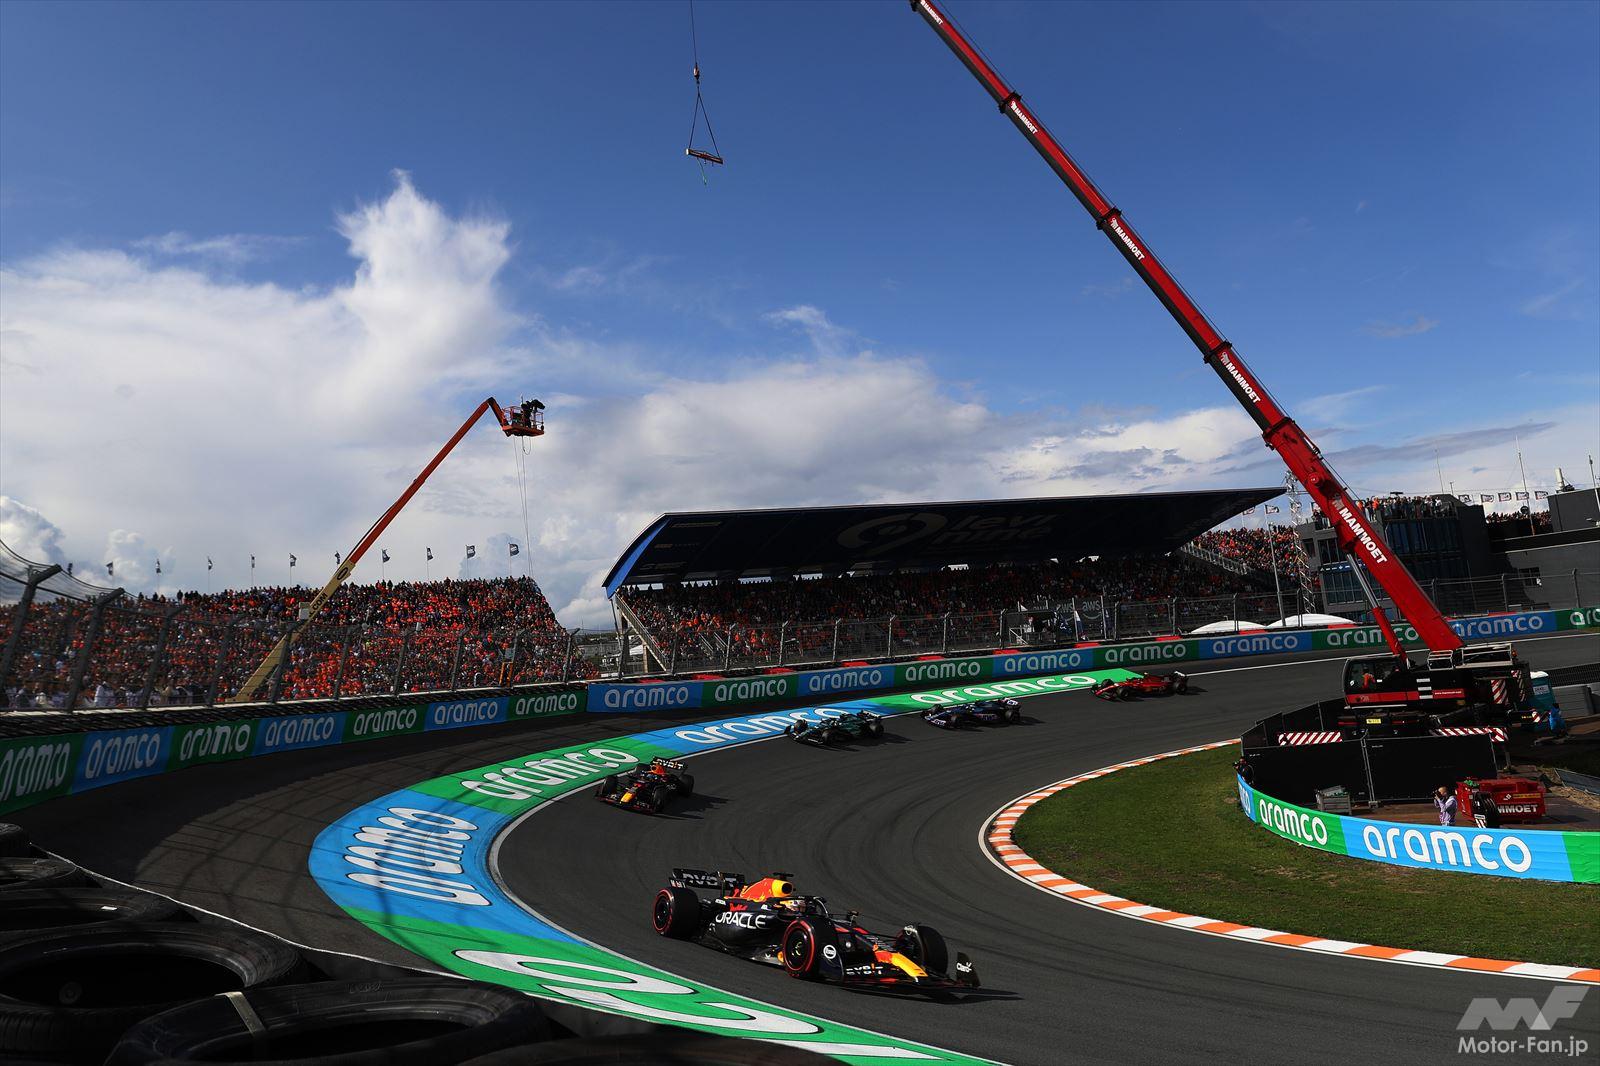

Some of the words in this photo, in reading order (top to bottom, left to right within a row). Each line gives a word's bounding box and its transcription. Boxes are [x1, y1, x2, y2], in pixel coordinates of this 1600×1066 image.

[1014, 107, 1038, 135] MAMMOET
[1114, 227, 1145, 262] MAMMOET
[1225, 362, 1261, 404] MAMMOET
[1338, 508, 1388, 564] MAMMOET
[1082, 600, 1100, 612] aws
[1105, 643, 1187, 663] aramco
[1213, 635, 1298, 654] aramco
[905, 662, 981, 681] aramco
[1004, 652, 1081, 673] aramco
[715, 679, 787, 702] aramco
[809, 669, 882, 692] aramco
[911, 675, 1097, 705] aramco
[515, 692, 577, 715] aramco
[604, 686, 689, 708] aramco
[353, 707, 417, 736] aramco
[434, 701, 498, 725] aramco
[675, 708, 849, 744] aramco
[265, 715, 335, 748] aramco
[84, 732, 161, 779] aramco
[461, 748, 640, 800] aramco
[1259, 798, 1328, 846] aramco
[1363, 825, 1532, 873] aramco
